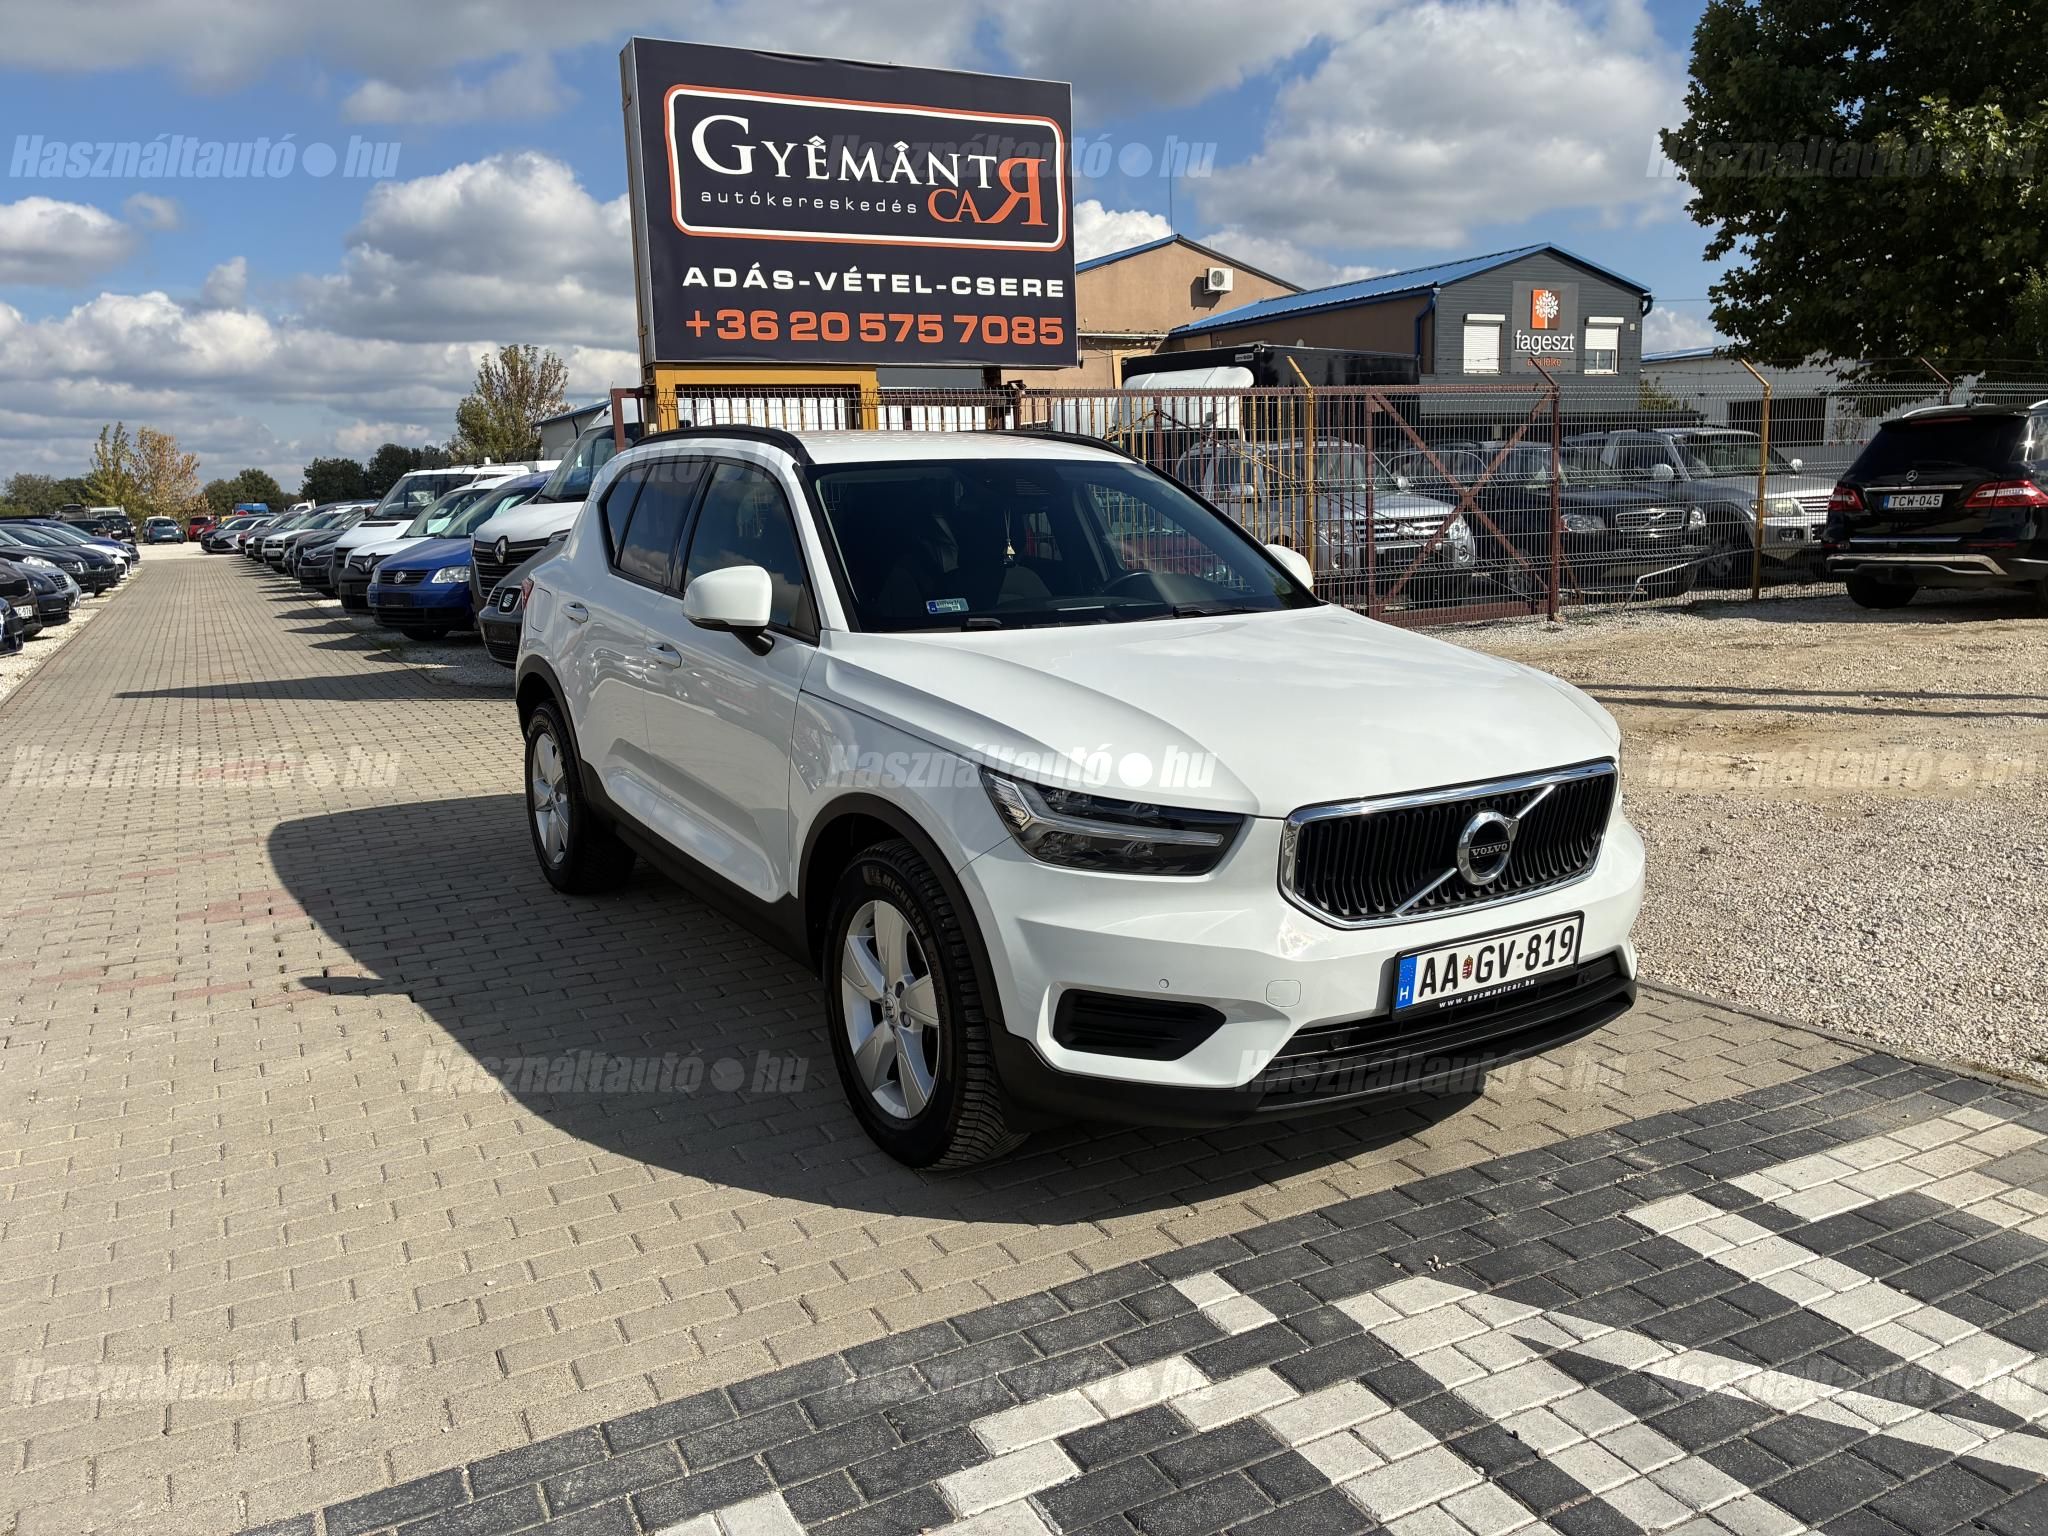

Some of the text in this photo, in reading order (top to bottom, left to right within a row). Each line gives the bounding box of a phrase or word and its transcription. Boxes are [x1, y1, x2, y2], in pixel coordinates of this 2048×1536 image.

[700, 189, 917, 214] autókereskedés
[682, 262, 1064, 299] ADÁS-VÉTEL-CSERE
[685, 309, 1064, 345] +36 20 575 7085
[1515, 330, 1575, 356] fageszt
[1892, 495, 1941, 507] TCW-045
[1469, 842, 1508, 857] VOLVO
[882, 874, 928, 938] MICHELIN
[1439, 978, 1536, 1009] www.gyemantcar.hu
